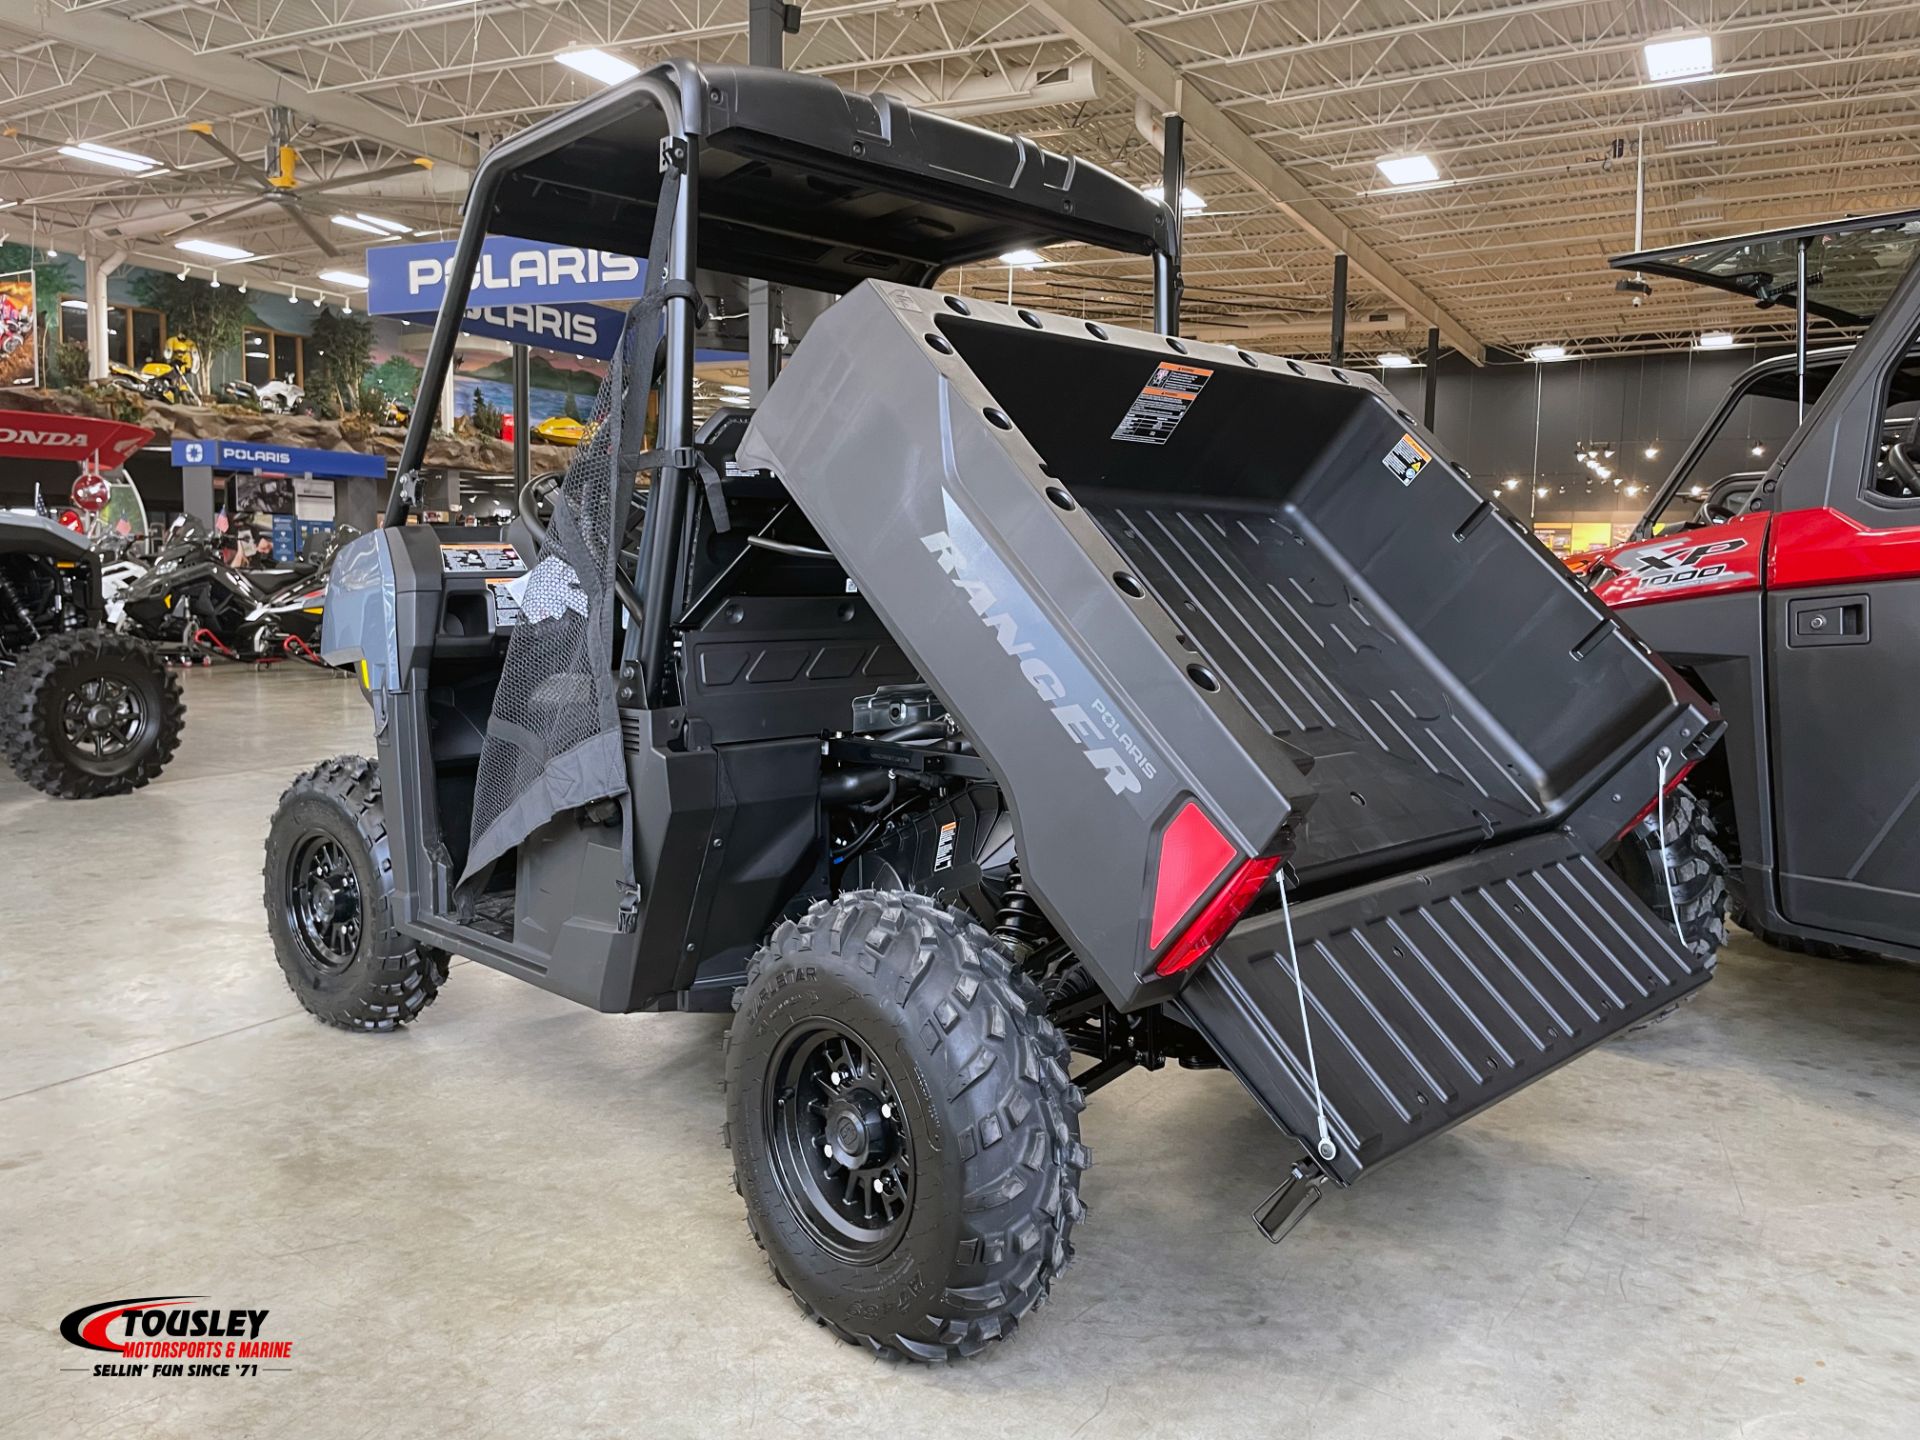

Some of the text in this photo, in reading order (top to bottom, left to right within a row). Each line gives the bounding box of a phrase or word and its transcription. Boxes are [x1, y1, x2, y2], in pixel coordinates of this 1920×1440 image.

[463, 304, 598, 345] LARIS
[0, 428, 89, 447] ONDA
[223, 448, 291, 463] POLARIS
[1637, 537, 1748, 572] XP
[1639, 564, 1726, 587] 1000
[920, 530, 1142, 796] RANGER
[1091, 698, 1157, 780] POLARIS
